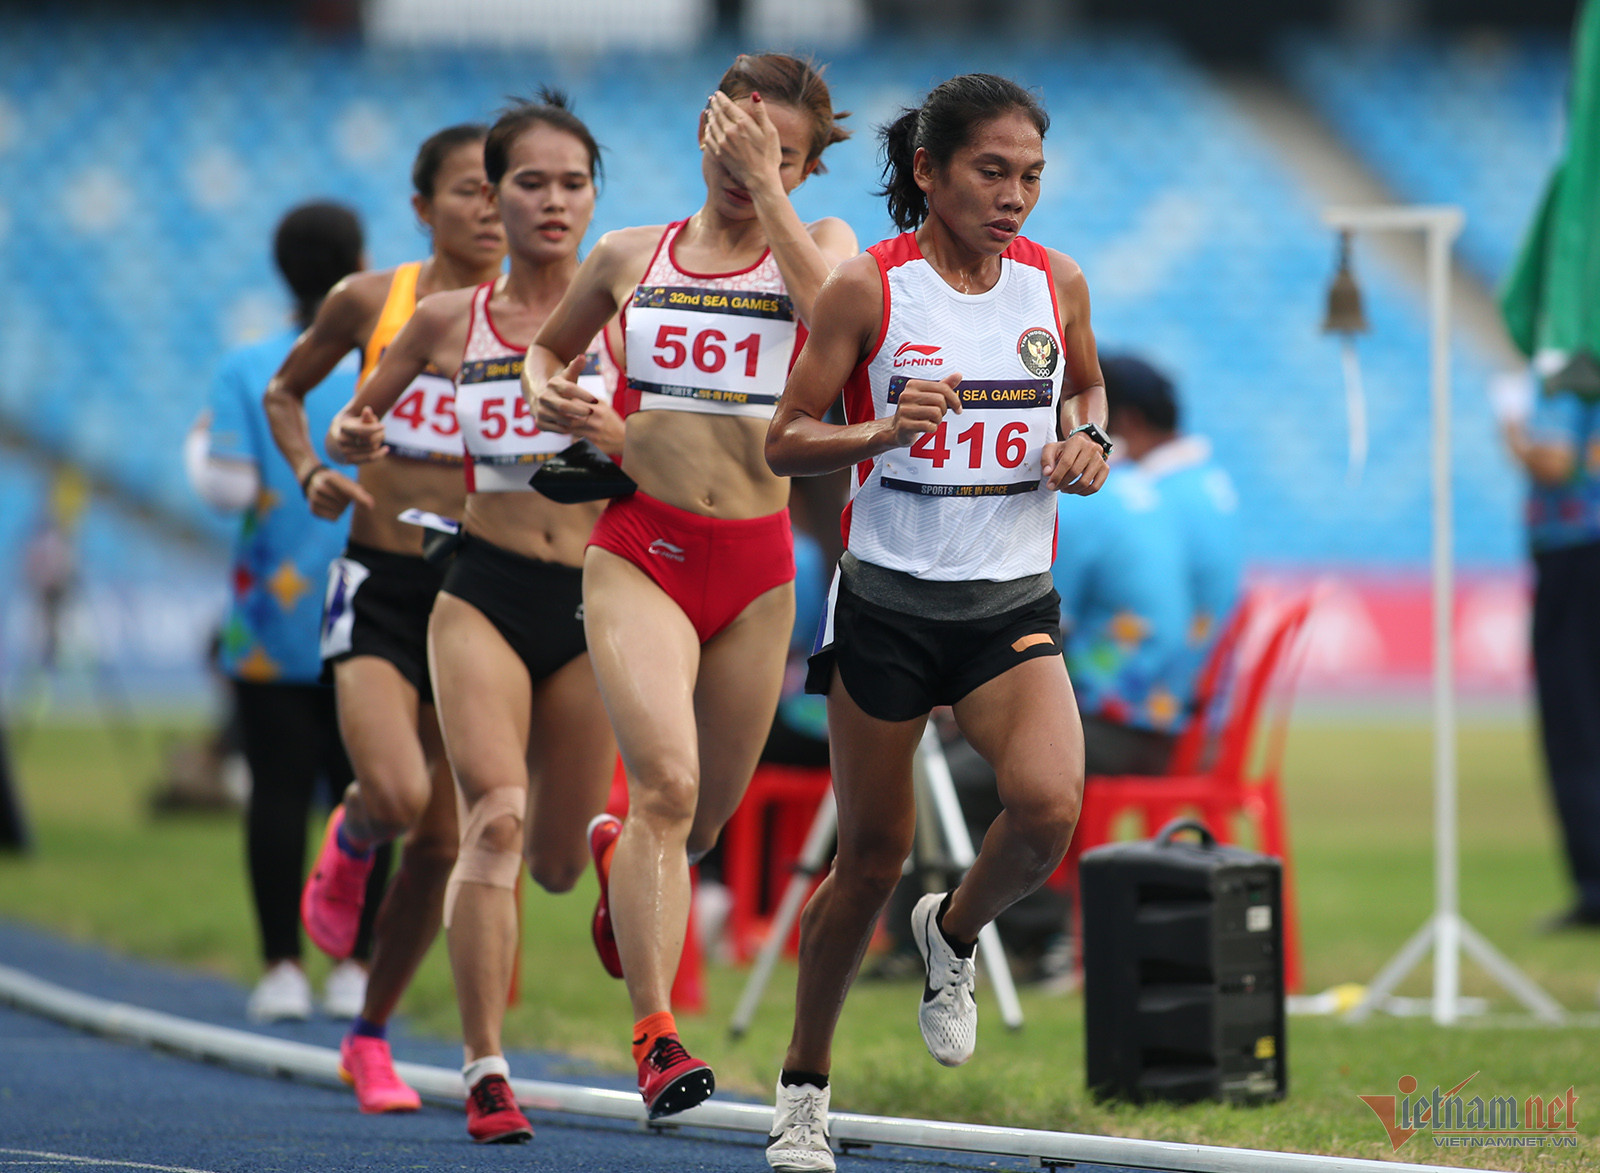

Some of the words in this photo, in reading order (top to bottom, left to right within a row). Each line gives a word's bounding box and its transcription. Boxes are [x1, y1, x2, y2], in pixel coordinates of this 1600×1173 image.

[669, 292, 700, 305] 32nd
[702, 295, 728, 307] SEA
[731, 298, 779, 312] GAMES
[652, 324, 761, 378] 561
[893, 358, 943, 367] LI-NING
[962, 389, 988, 401] SEA
[991, 389, 1037, 401] GAMES
[392, 389, 461, 435] 45
[480, 397, 542, 440] 55
[909, 421, 1030, 469] 416
[921, 485, 954, 496] SPORTS
[956, 486, 973, 496] LIVE
[974, 486, 983, 496] IN
[984, 485, 1008, 495] PEACE
